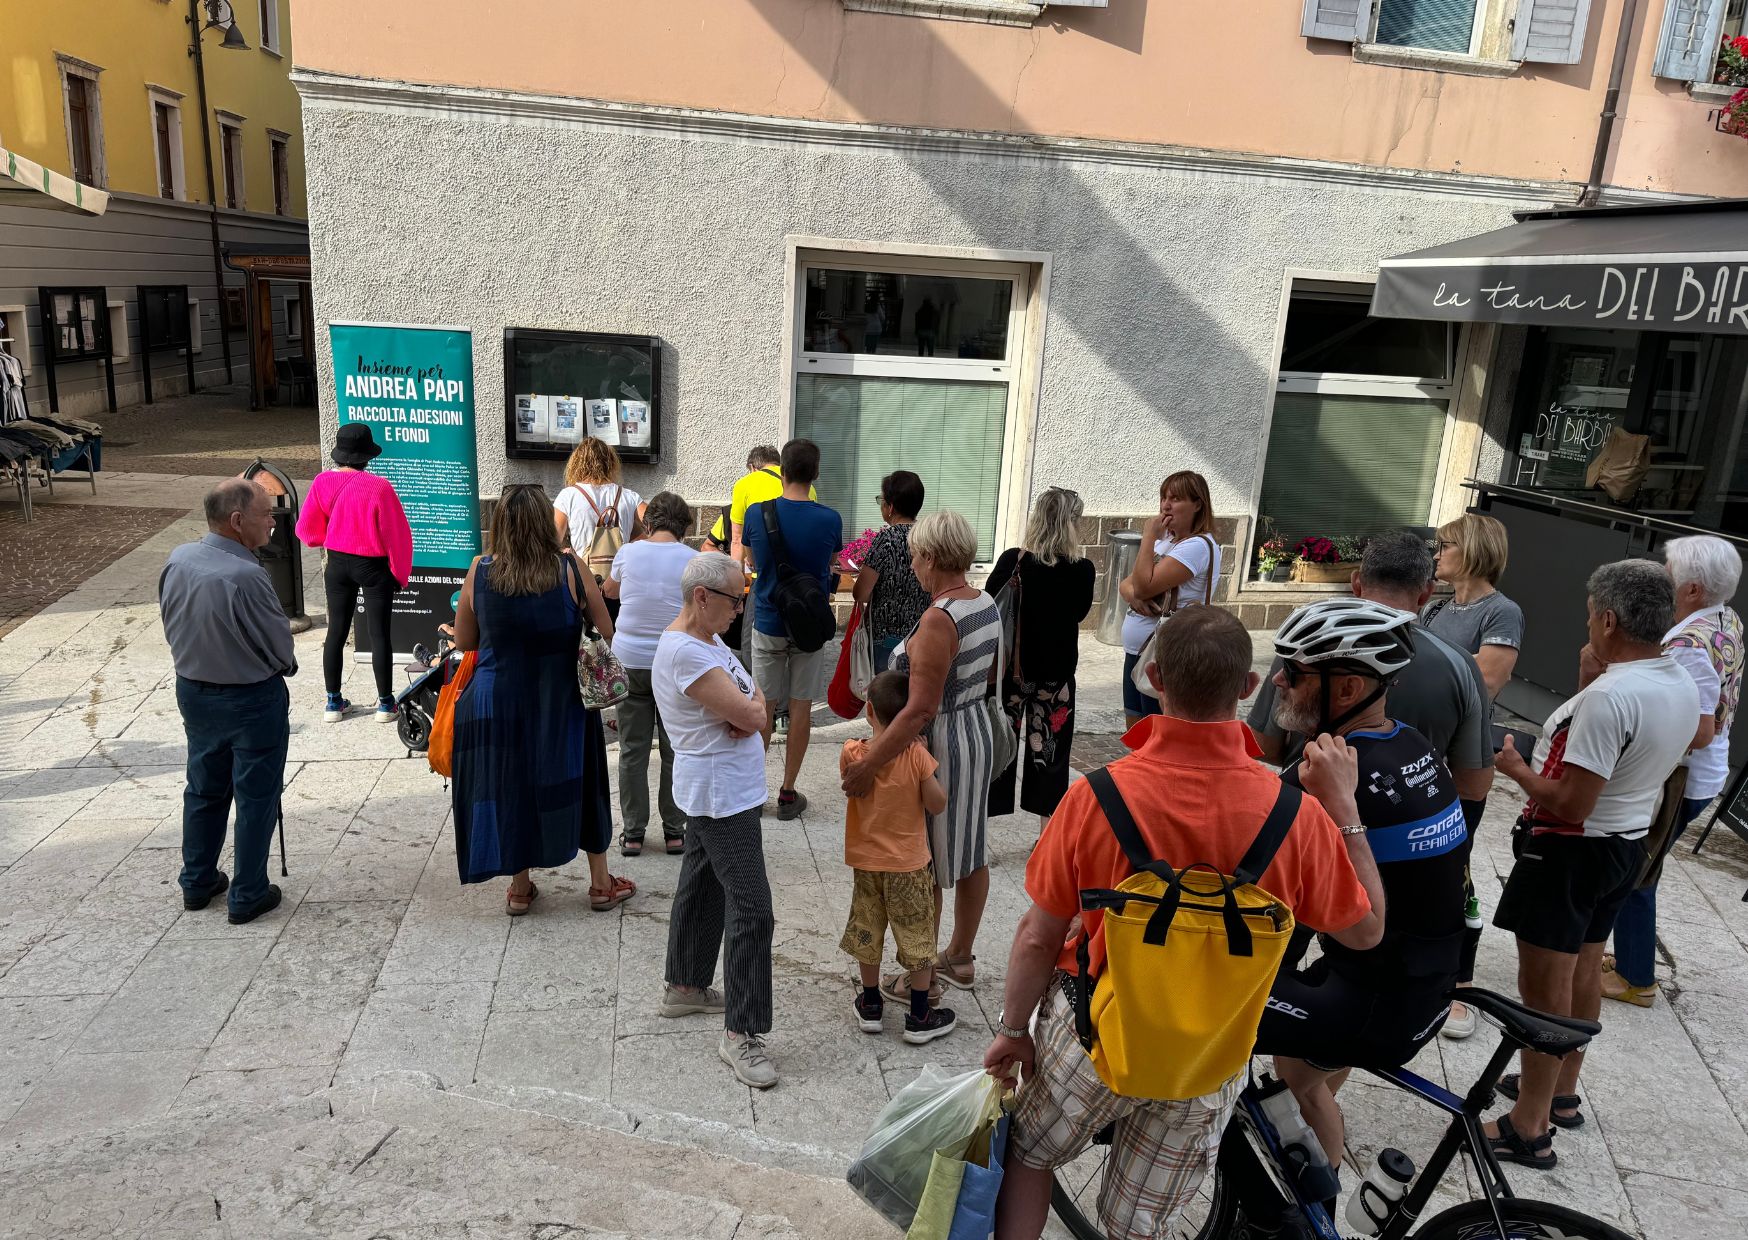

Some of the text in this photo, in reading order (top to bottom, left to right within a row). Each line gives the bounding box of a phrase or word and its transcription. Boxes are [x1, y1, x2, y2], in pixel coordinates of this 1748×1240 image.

[1432, 282, 1471, 307] la
[1480, 281, 1587, 311] tana
[1595, 267, 1659, 321] DEL
[358, 355, 446, 384] Insieme per
[345, 375, 464, 403] ANDREA PAPI
[348, 406, 463, 426] RACCOLTA ADESIONI
[1535, 413, 1559, 441] DEL
[385, 426, 430, 443] E FONDI
[424, 576, 442, 584] AZIONI
[442, 577, 452, 585] DEL
[1401, 752, 1433, 775] zzyzx
